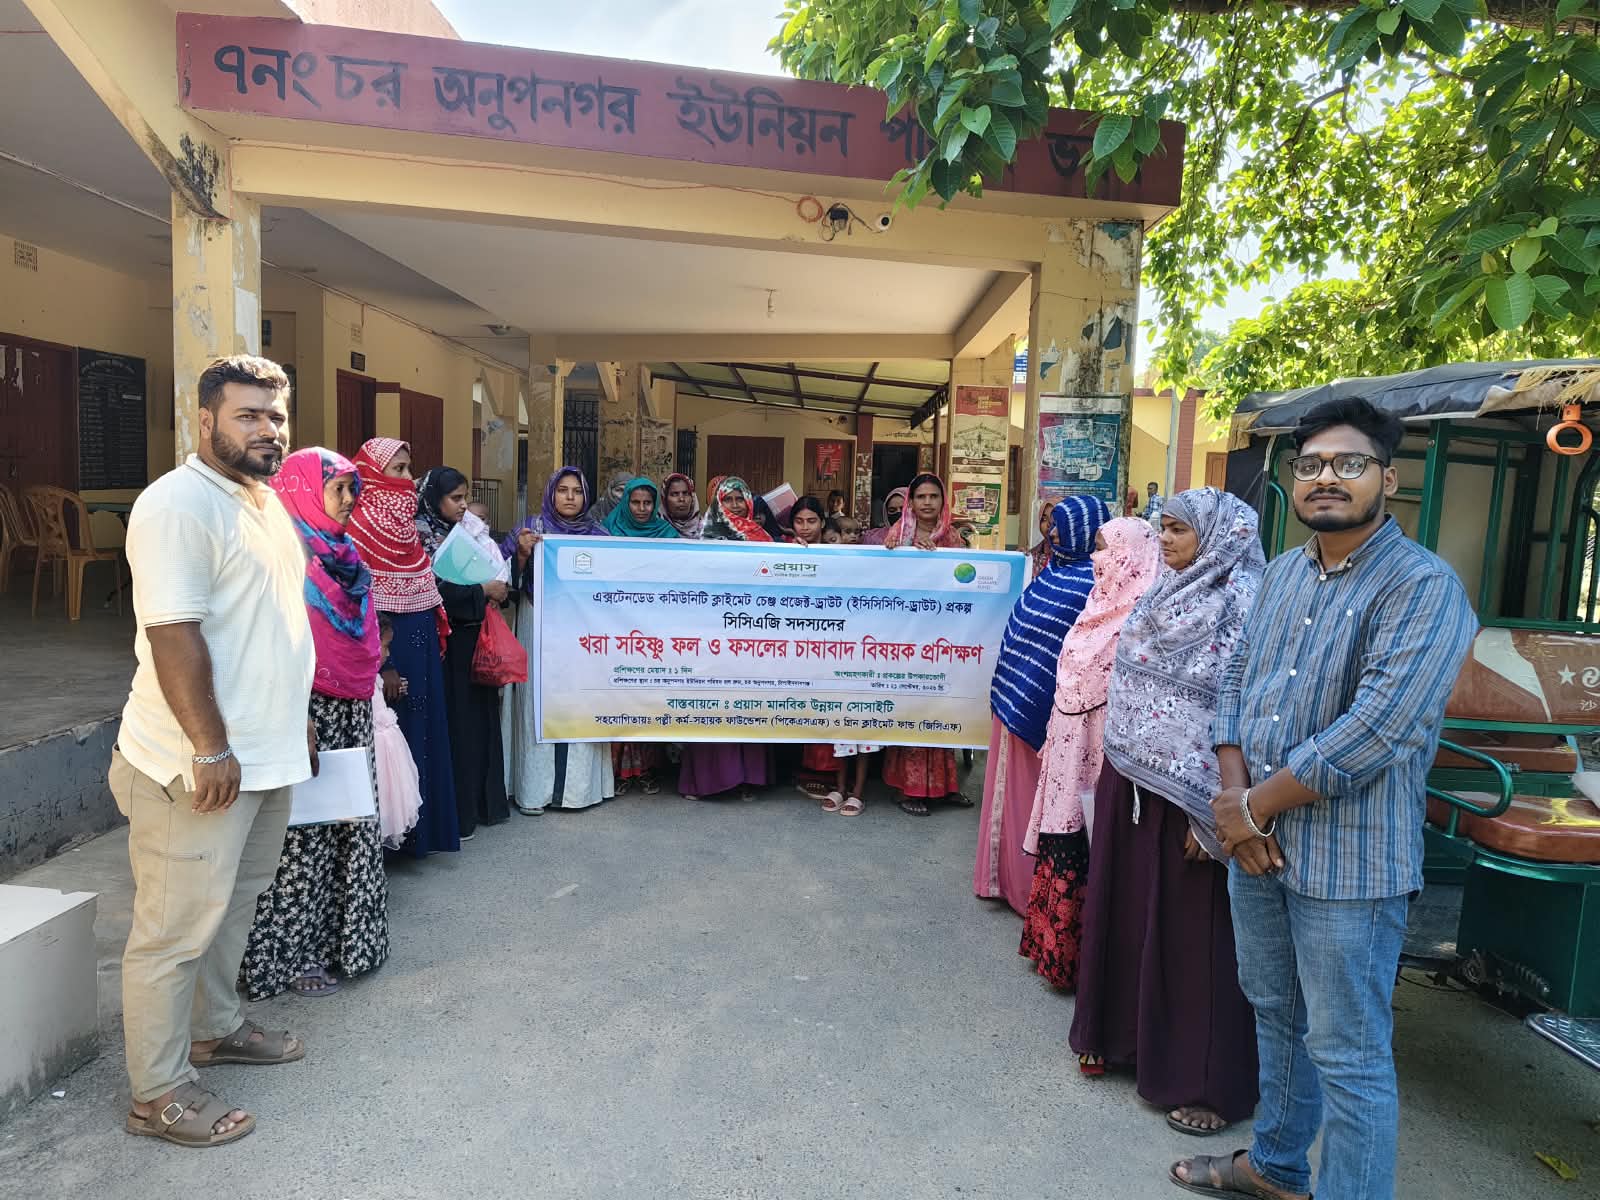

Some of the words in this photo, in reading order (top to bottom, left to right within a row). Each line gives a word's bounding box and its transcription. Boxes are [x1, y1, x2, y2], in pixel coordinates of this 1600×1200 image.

[213, 44, 322, 108] ৭নং
[328, 54, 409, 109] চর
[432, 65, 642, 134] অনুপনগর
[668, 75, 857, 159] ইউনিয়ন
[773, 563, 820, 571] প্রয়াস
[658, 590, 709, 605] কমিউনিটি
[711, 592, 752, 607] ক্লাইমেট
[846, 595, 942, 615] (ইসিসিসিপি-ড্রাউট)
[945, 601, 973, 614] প্রকল্প
[723, 612, 781, 630] সিসিএজি
[784, 617, 846, 631] সদস্যদের
[579, 633, 610, 656] খরা
[615, 630, 665, 662] সহিষ্ণু
[670, 637, 702, 656] ফল
[708, 639, 721, 655] ও
[727, 638, 789, 658] ফসলের
[794, 637, 857, 661] চাষাবাদ
[861, 635, 917, 663] বিষয়ক
[920, 637, 985, 665] প্রশিক্ষণ
[666, 698, 720, 710] বাস্তবায়নে
[733, 698, 764, 710] প্রয়াস
[766, 697, 807, 711] মানবিক
[810, 698, 843, 713] উন্নয়ন
[846, 699, 896, 713] সোসাইটি
[654, 713, 673, 726] পল্লী
[674, 714, 723, 725] কর্ম-সহায়ক
[726, 715, 768, 726] ফাউন্ডেশন
[770, 715, 830, 727] (পিকেএসএফ)
[843, 717, 859, 727] গ্রিন
[861, 718, 894, 729] ক্লাইমেট
[896, 720, 917, 729] ফান্ড
[918, 720, 962, 733] (জিসিএফ)
